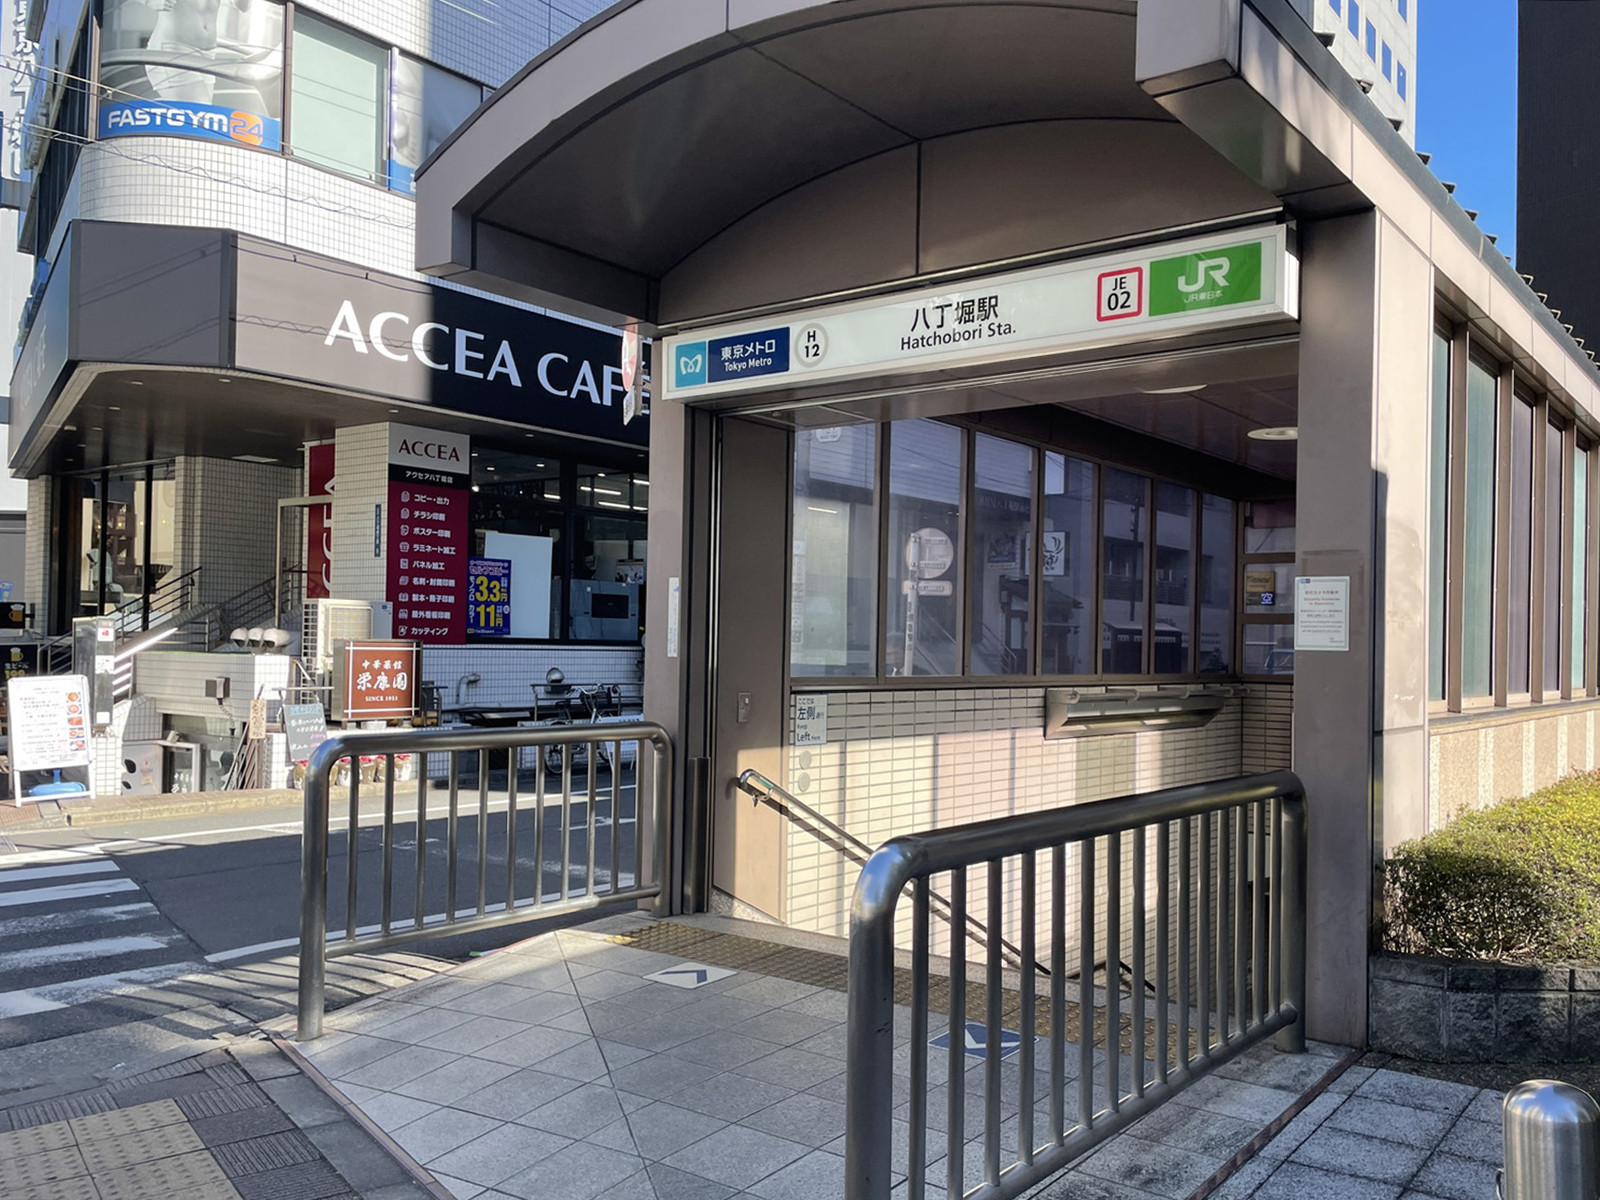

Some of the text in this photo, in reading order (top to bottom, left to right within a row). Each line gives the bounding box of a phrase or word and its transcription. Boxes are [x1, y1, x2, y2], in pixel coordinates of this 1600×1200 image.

[108, 108, 228, 132] FASTGYM
[1112, 276, 1127, 291] JE
[1178, 257, 1230, 292] JR
[1107, 291, 1131, 310] 02
[1184, 290, 1223, 304] JR東日本
[911, 295, 998, 332] 八丁堀駅
[324, 300, 522, 387] ACCEA
[807, 330, 816, 343] H
[901, 322, 1016, 350] Hatchobori Sta.
[721, 339, 776, 360] 東京メトロ
[805, 344, 820, 358] 12
[724, 358, 772, 373] Tokyo Metro
[399, 439, 460, 462] ACCEA
